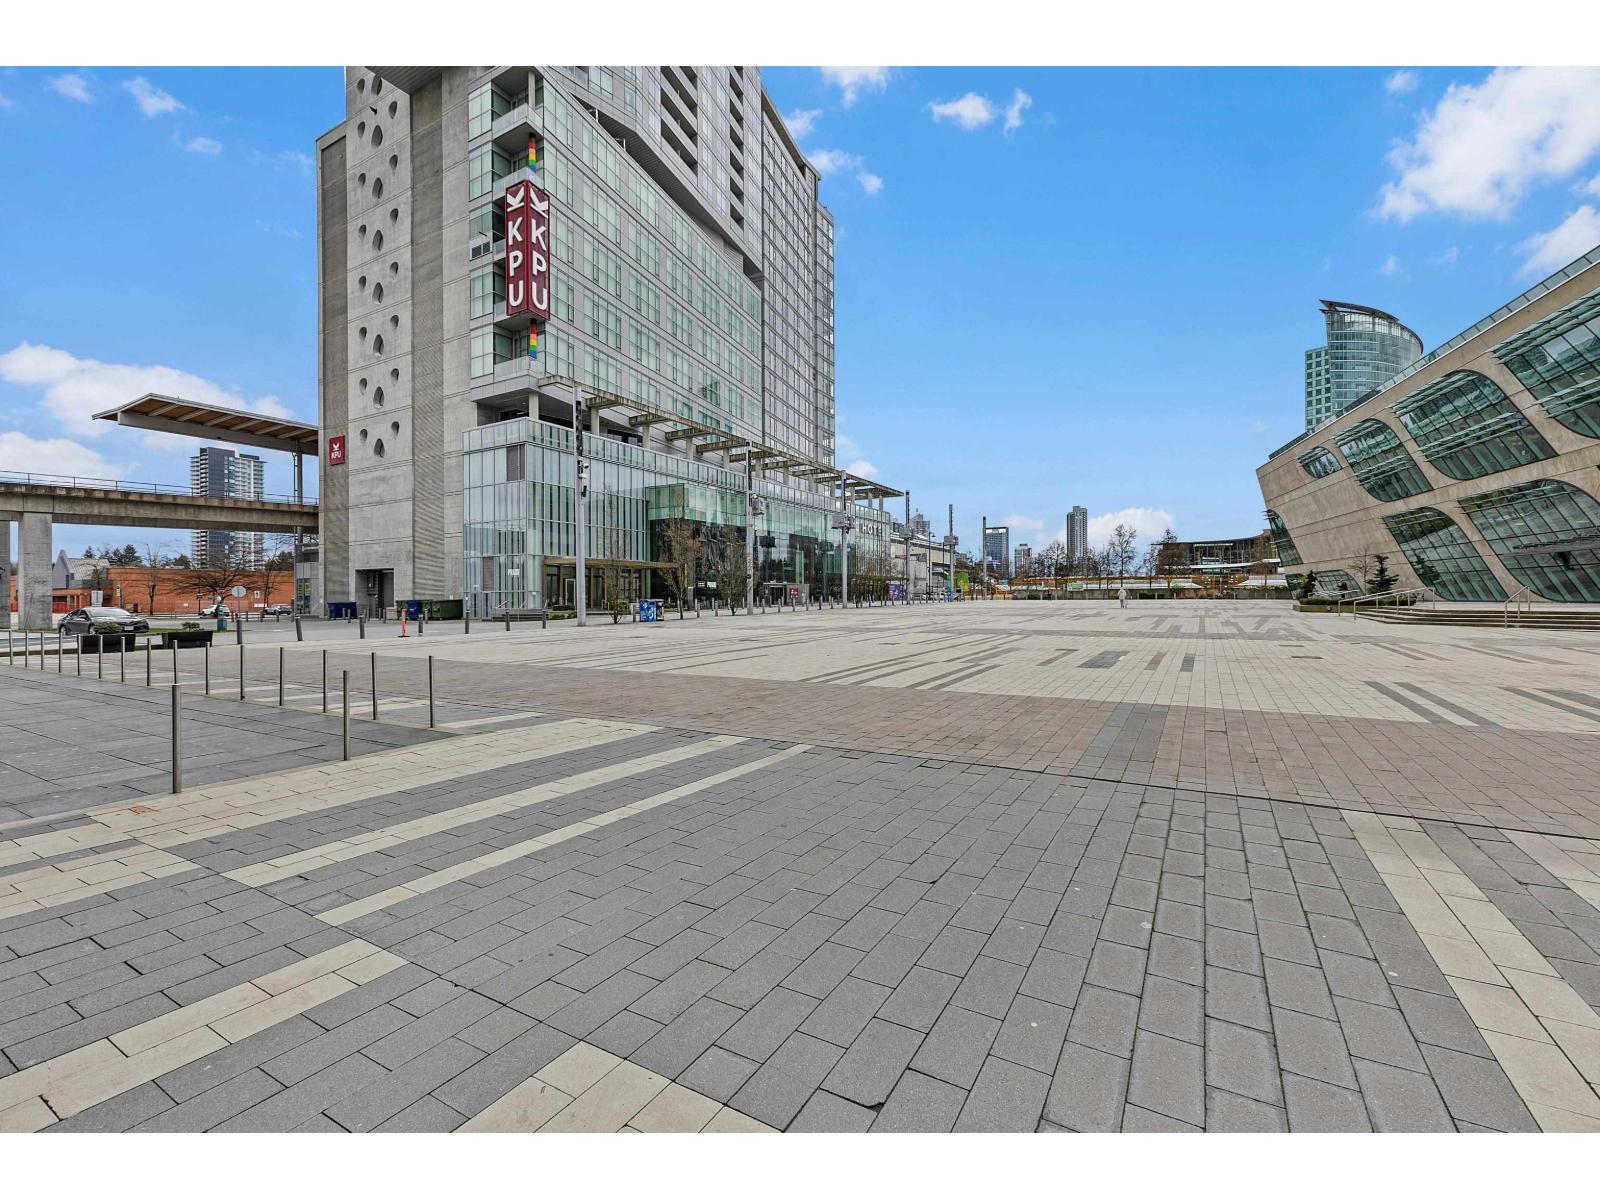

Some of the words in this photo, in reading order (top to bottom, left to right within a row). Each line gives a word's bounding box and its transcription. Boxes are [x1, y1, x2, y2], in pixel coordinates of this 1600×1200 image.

[508, 217, 524, 307] KPU
[531, 218, 548, 310] KPU
[331, 450, 342, 459] KPU
